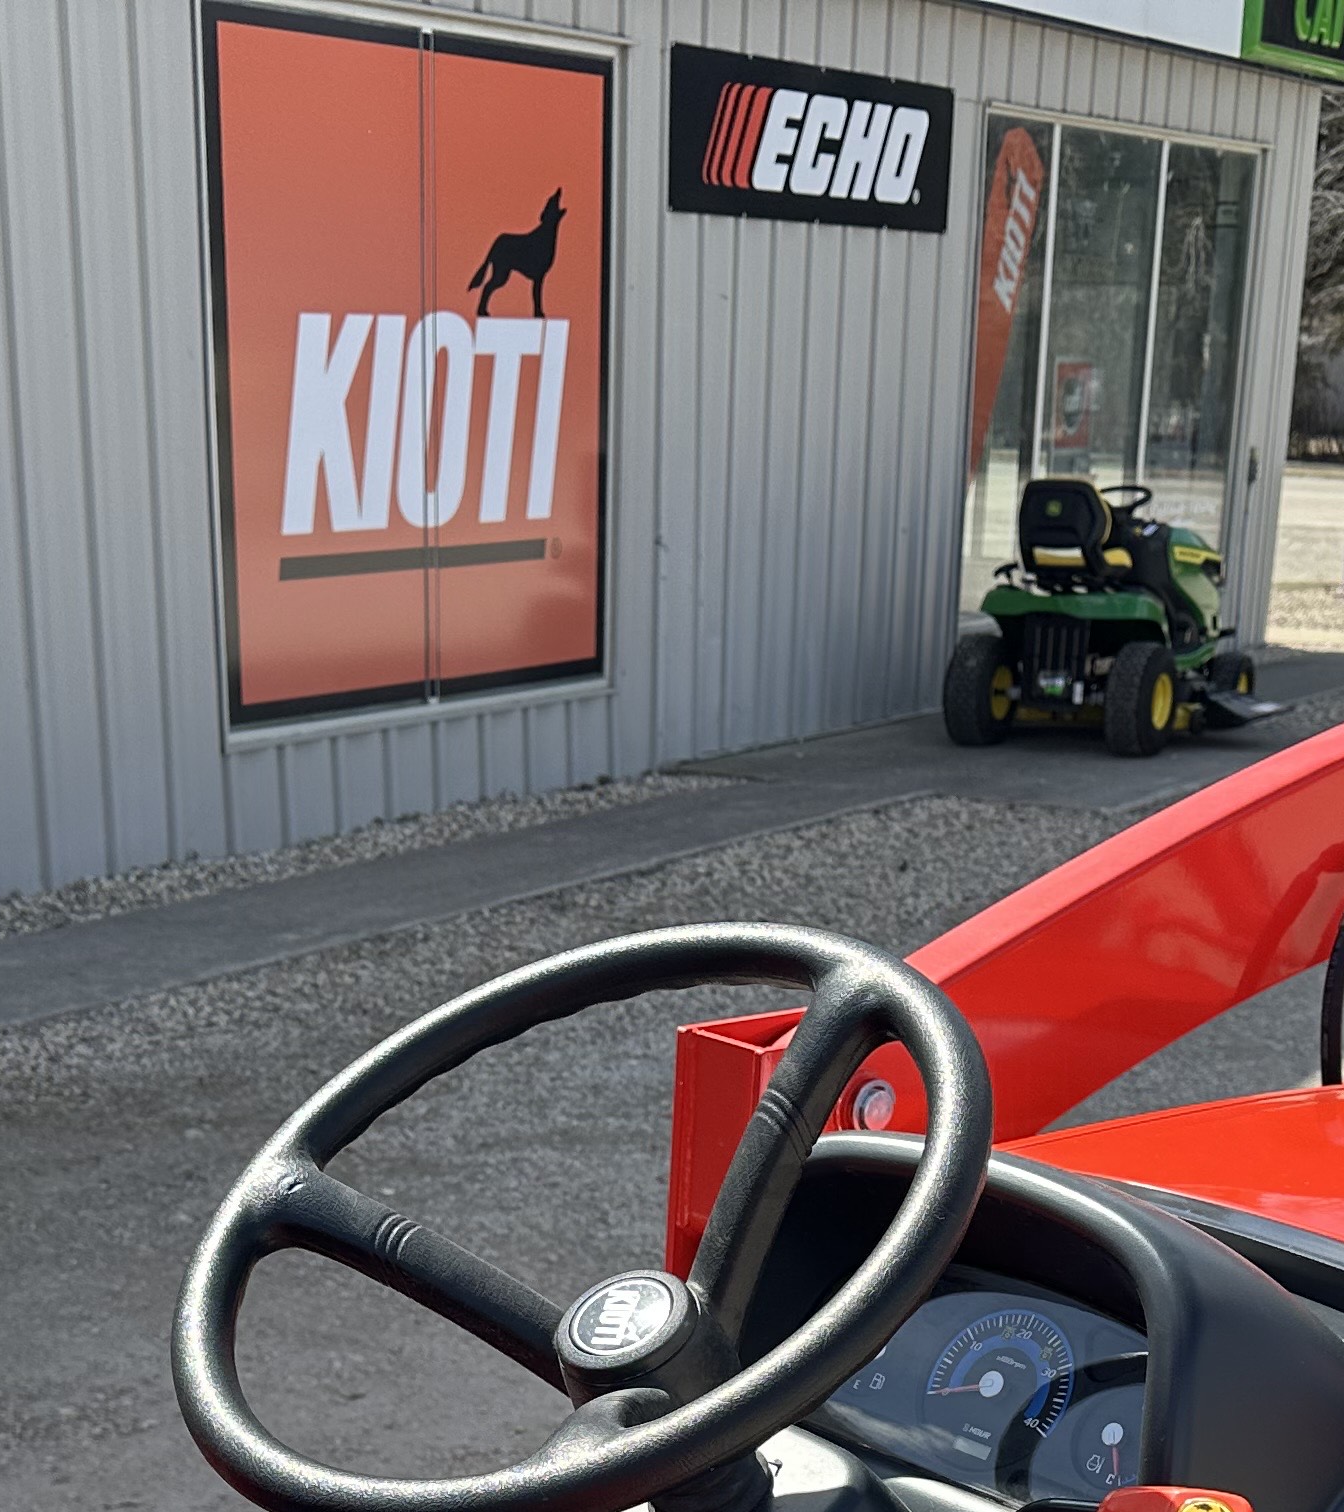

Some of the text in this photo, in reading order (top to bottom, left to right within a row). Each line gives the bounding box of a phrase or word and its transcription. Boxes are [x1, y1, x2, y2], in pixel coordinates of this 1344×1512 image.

[751, 87, 930, 205] ECHO
[993, 167, 1038, 316] KIOTI
[280, 310, 571, 536] KIOTI
[1016, 1328, 1033, 1341] 20
[969, 1341, 983, 1352] 10
[1041, 1367, 1057, 1379] 30
[1023, 1416, 1040, 1429] 40
